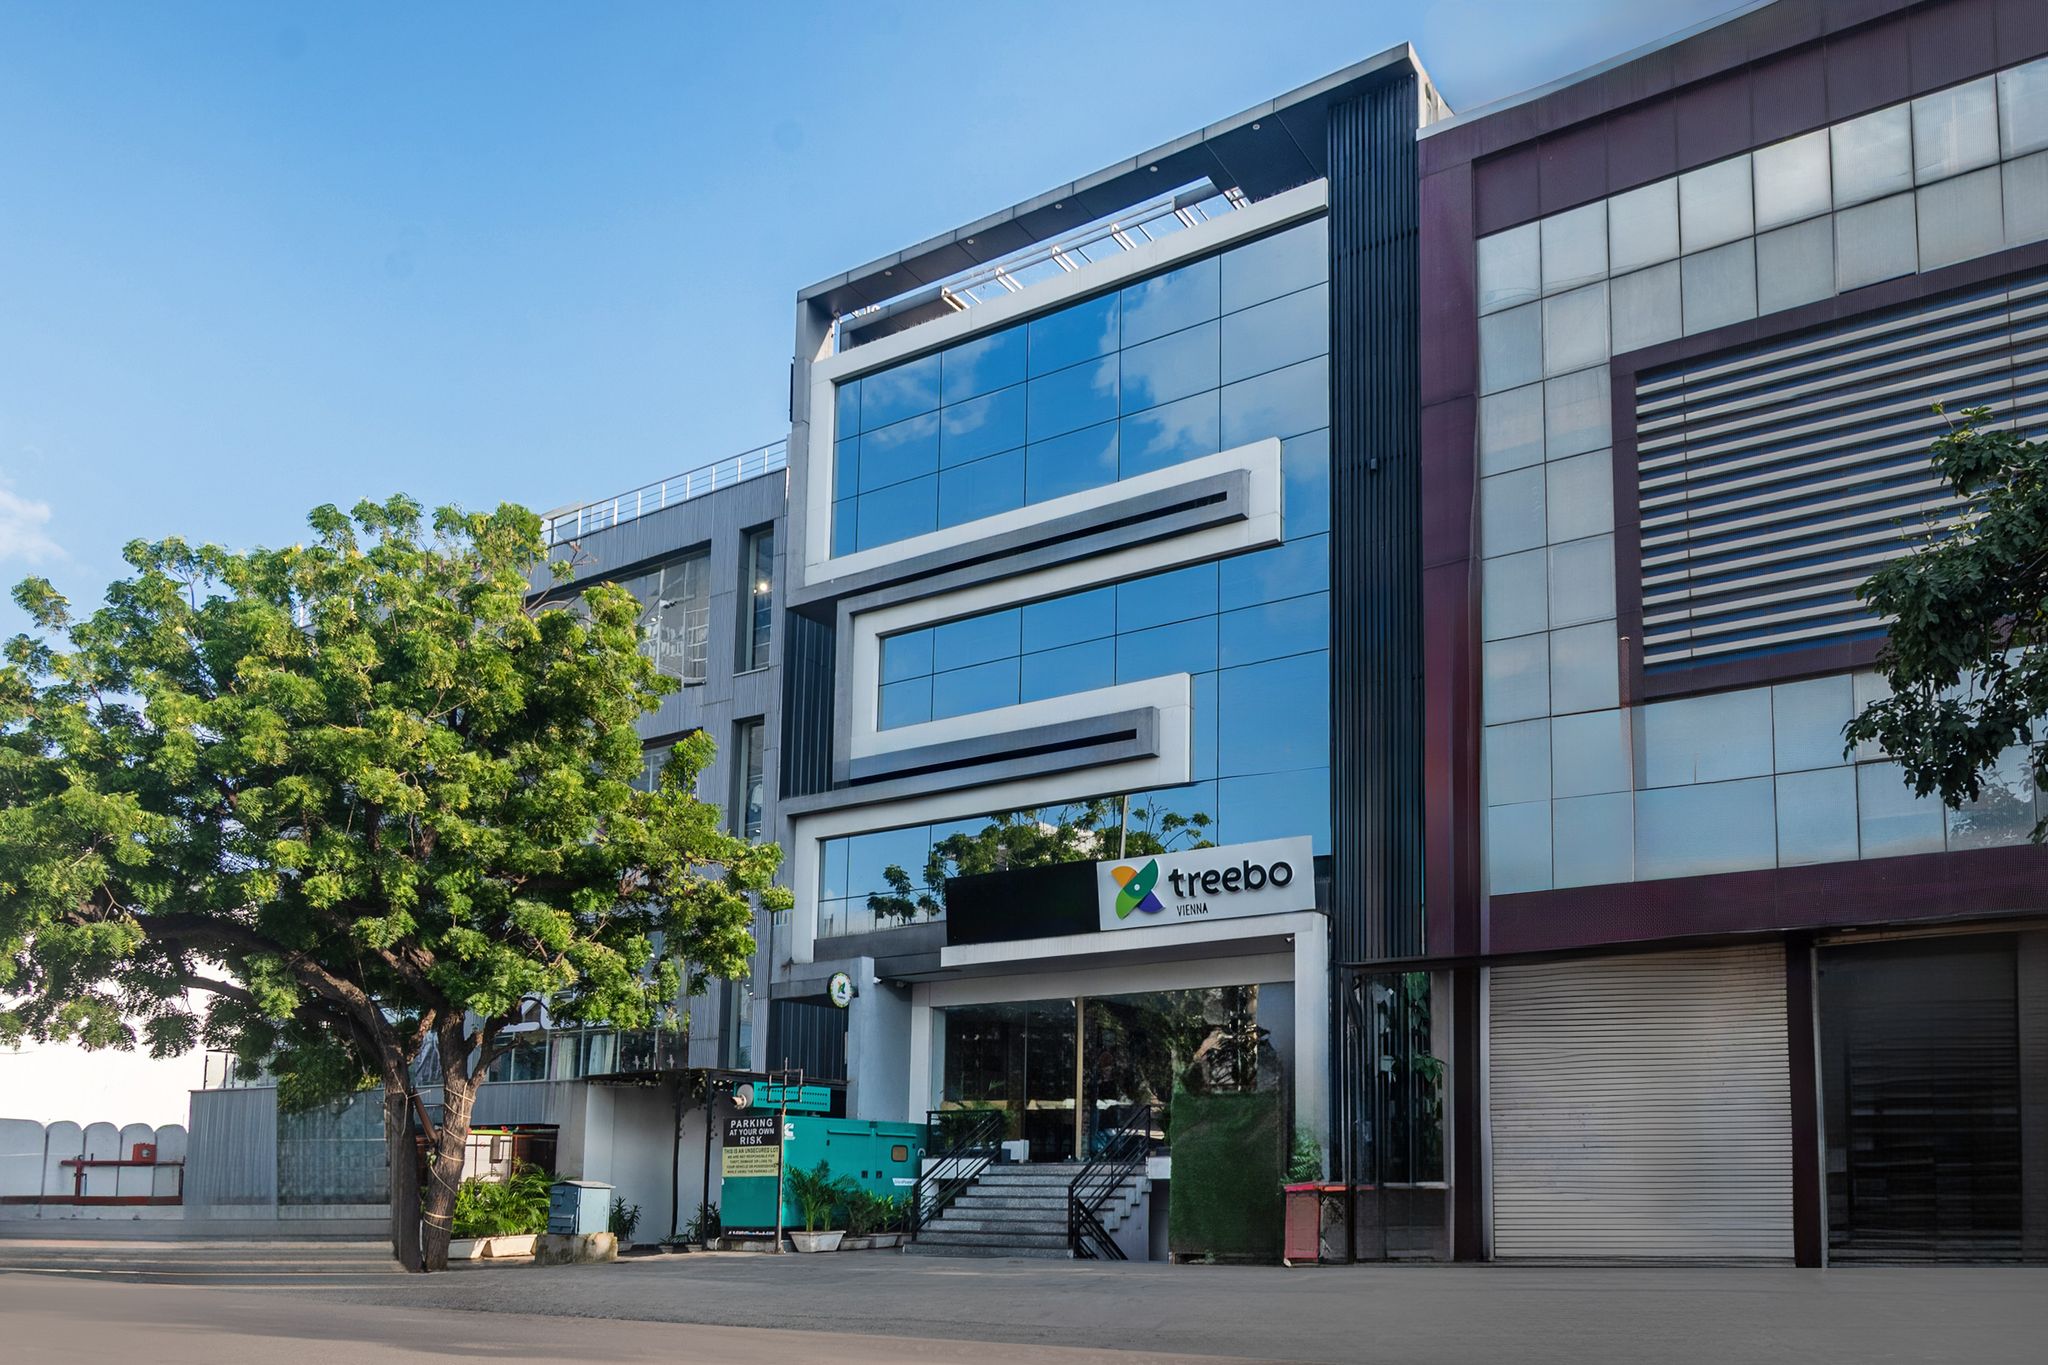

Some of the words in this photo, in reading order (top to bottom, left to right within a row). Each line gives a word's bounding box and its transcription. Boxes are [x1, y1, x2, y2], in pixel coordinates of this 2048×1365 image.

[1168, 859, 1294, 898] treebo
[1177, 902, 1209, 917] VIENNA
[731, 1118, 773, 1128] PARKING
[739, 1128, 757, 1136] YOUR
[740, 1136, 762, 1145] RISK
